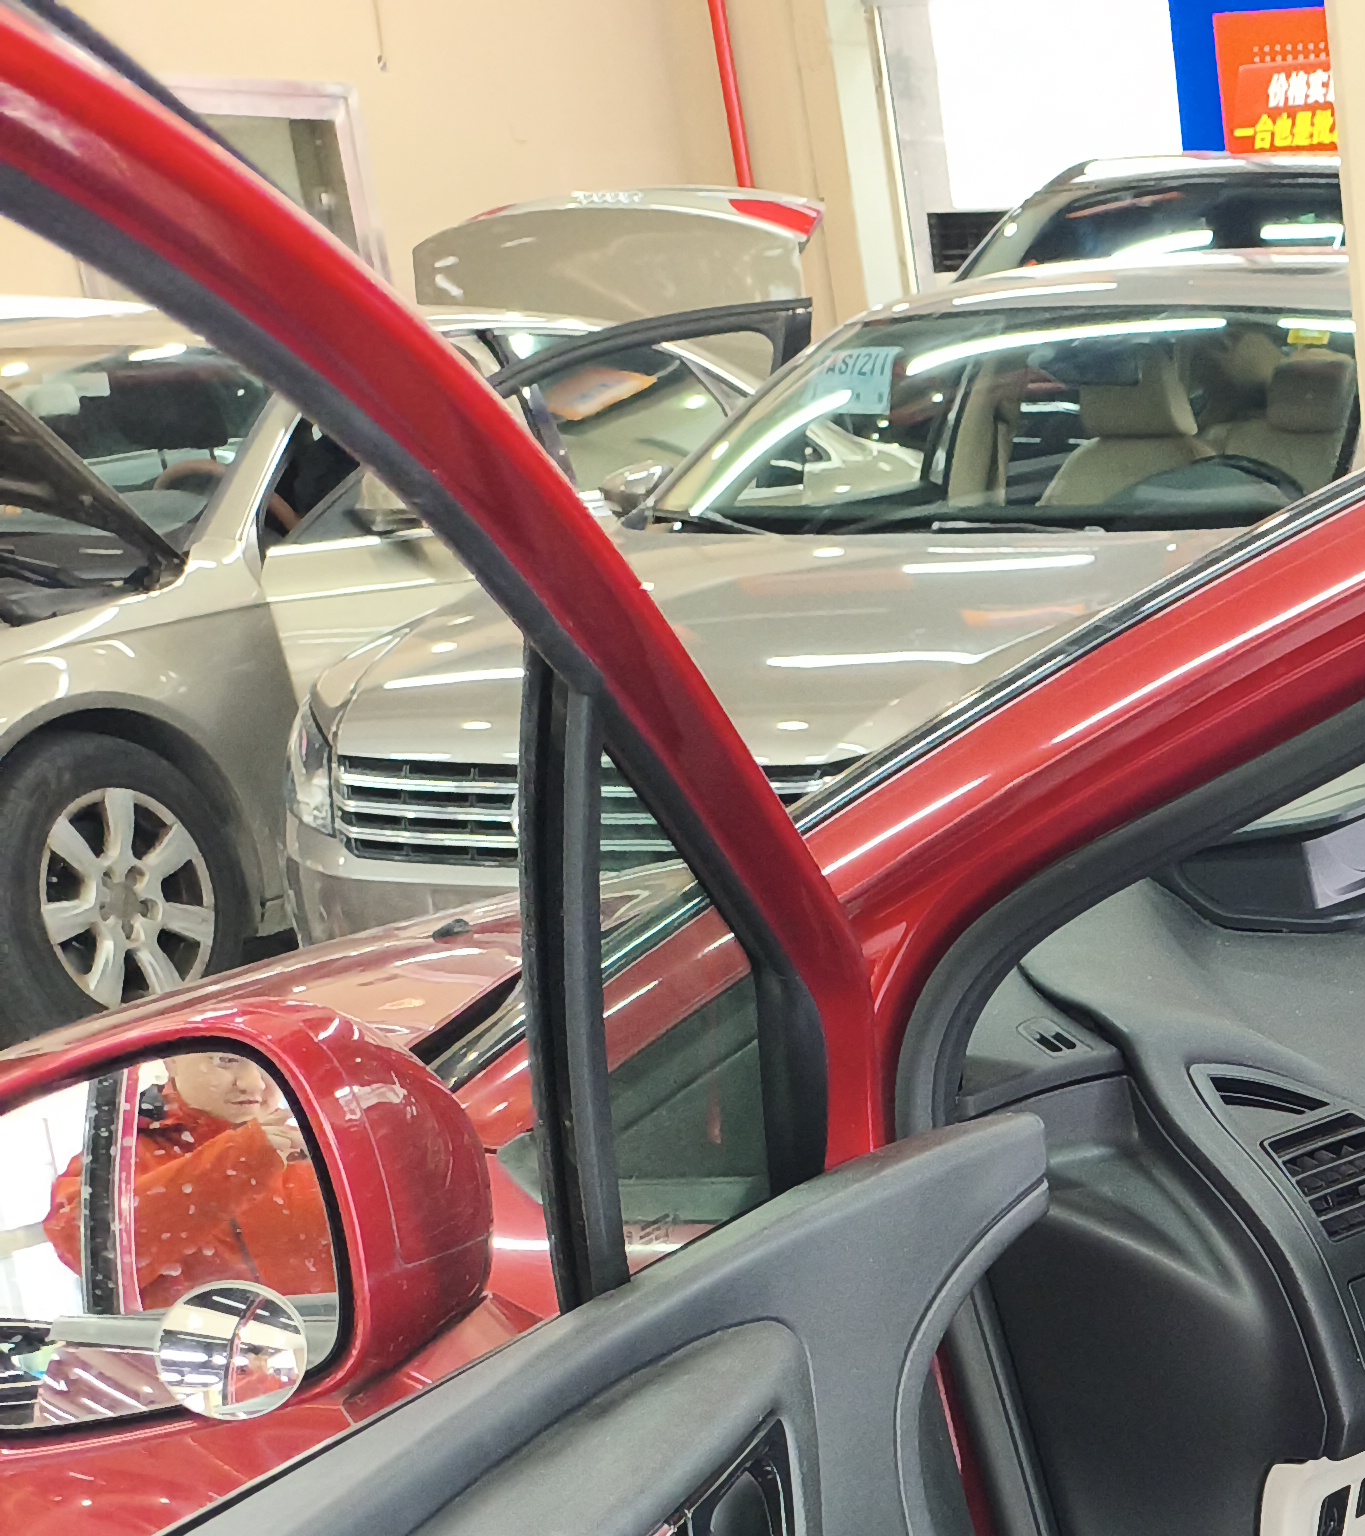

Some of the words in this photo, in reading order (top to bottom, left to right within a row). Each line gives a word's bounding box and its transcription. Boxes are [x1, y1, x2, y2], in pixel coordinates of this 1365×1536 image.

[1233, 109, 1339, 150] 一台也是批
